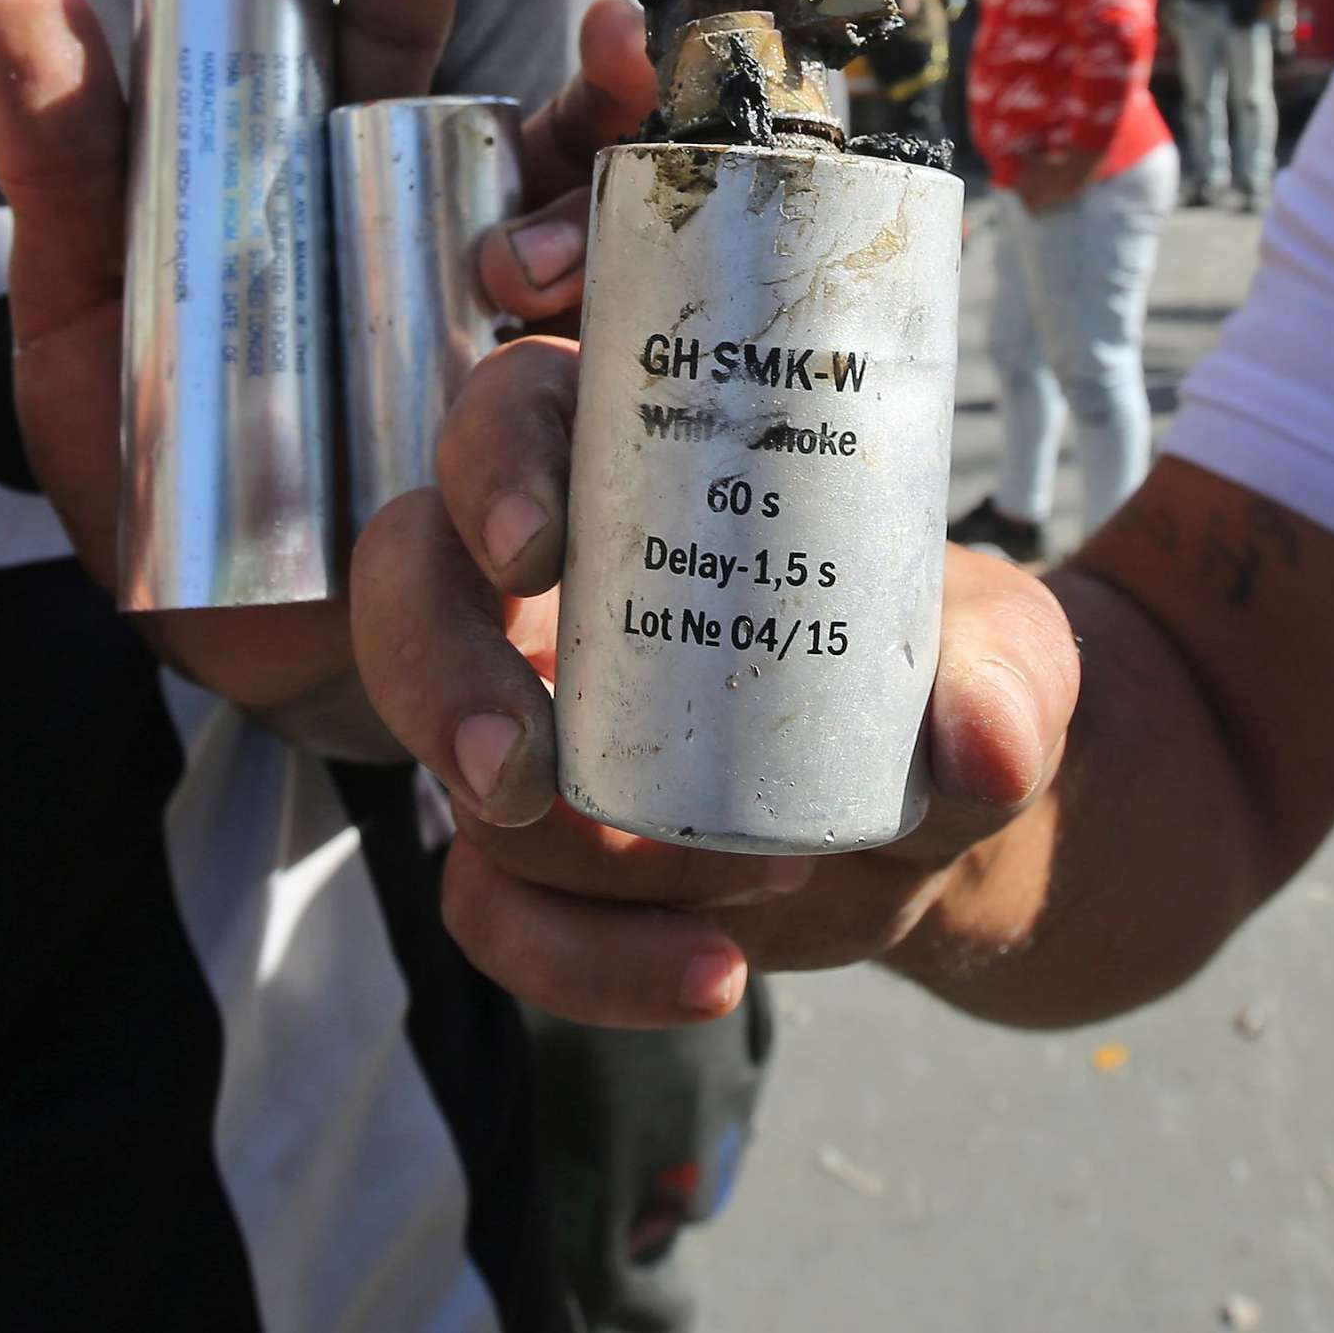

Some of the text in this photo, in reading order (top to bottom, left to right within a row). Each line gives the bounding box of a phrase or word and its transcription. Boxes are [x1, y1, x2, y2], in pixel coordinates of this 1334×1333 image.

[641, 333, 867, 393] GH SMK-W
[640, 403, 729, 443] Whit
[707, 480, 780, 517] 60 s
[818, 561, 836, 588] s
[624, 599, 673, 641] Lot
[731, 615, 848, 660] 04/15
